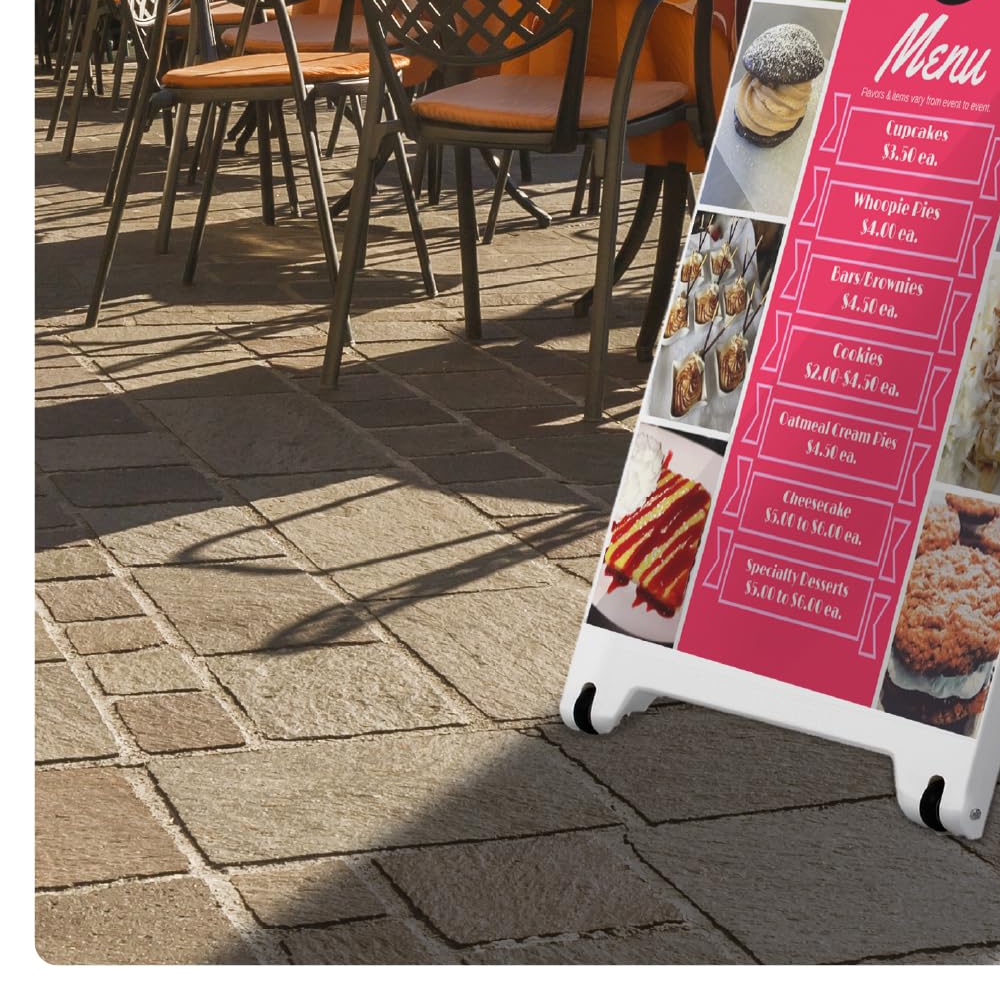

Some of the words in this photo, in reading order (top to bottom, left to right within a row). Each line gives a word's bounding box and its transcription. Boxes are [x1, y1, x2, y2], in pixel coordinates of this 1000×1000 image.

[873, 12, 992, 86] Menu
[860, 87, 885, 100] Flavors
[886, 89, 892, 101] &
[892, 91, 910, 103] items
[911, 94, 925, 107] vary
[926, 95, 941, 107] from
[942, 98, 962, 109] event
[962, 100, 970, 110] to
[885, 119, 949, 141] Cupcakes
[881, 143, 917, 163] $3.50
[917, 151, 938, 167] ea.
[854, 191, 910, 216] Whoopie
[911, 201, 941, 221] Pies
[860, 218, 896, 239] $4.00
[897, 228, 918, 244] ea.
[830, 265, 924, 297] Bars/Brownies
[841, 292, 878, 314] $4.50
[878, 303, 898, 319] ea.
[832, 342, 884, 367] Cookies
[804, 361, 880, 393] $2.00-$4.50
[880, 381, 900, 397] ea.
[779, 411, 831, 435] Oatmeal
[831, 422, 871, 445] Cream
[872, 431, 898, 450] Pies
[806, 439, 838, 460] $4.50
[839, 450, 857, 465] ea.
[782, 489, 852, 519] Cheesecake
[764, 507, 795, 528] $5.00
[796, 516, 809, 533] to
[811, 519, 844, 541] $6.00
[844, 530, 862, 546] ea.
[745, 558, 799, 587] Specialty
[799, 571, 850, 598] Desserts
[744, 580, 775, 601] $5.00
[776, 589, 789, 605] to
[790, 592, 824, 614] $6.00
[824, 605, 842, 620] ea.
